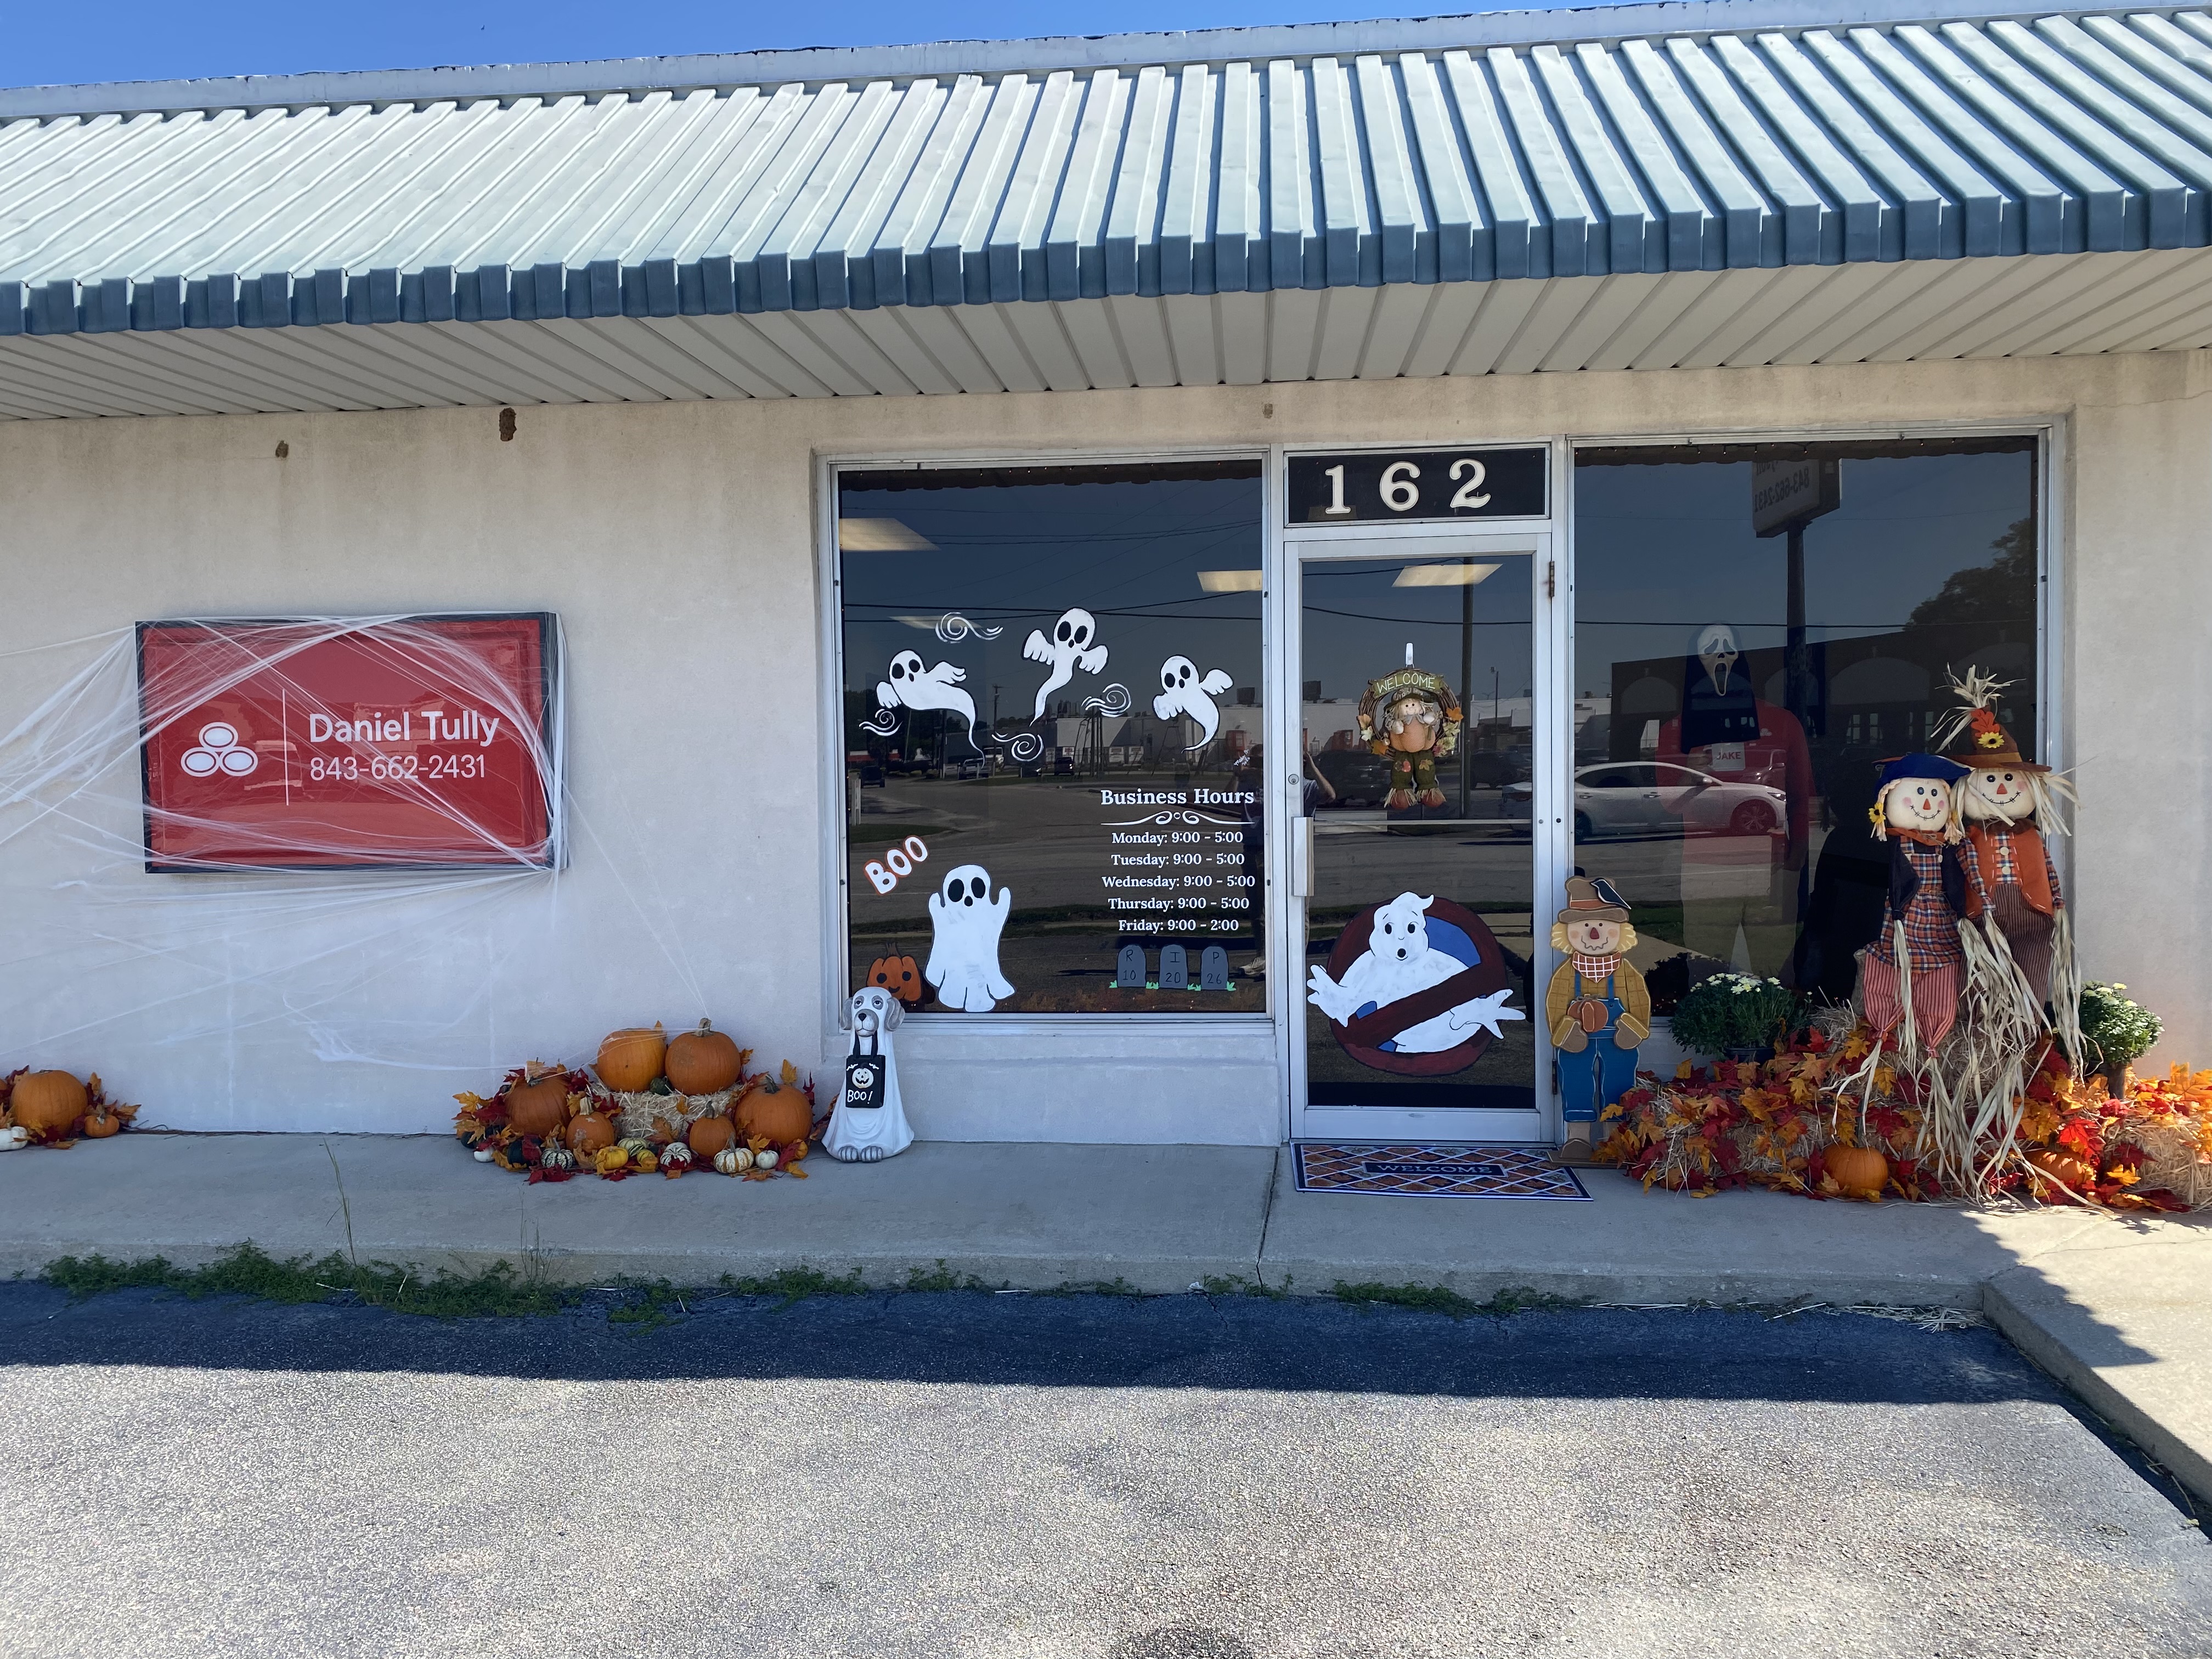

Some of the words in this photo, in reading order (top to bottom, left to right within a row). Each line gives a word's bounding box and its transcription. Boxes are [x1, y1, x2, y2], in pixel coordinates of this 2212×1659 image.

[1325, 459, 1491, 514] 162
[1376, 673, 1435, 693] WELCOME
[309, 712, 410, 743] Daniel
[421, 709, 499, 747] Tully
[1717, 751, 1741, 760] JAKE
[309, 754, 486, 782] 843-662-2431
[1101, 788, 1187, 805] Business
[1194, 788, 1254, 804] Hours
[1111, 832, 1167, 846] Monday:
[1171, 832, 1200, 843] 9:00
[1215, 831, 1243, 843] 5:00
[864, 836, 928, 895] BOO
[1111, 854, 1169, 868] Tuesday:
[1173, 854, 1202, 865] 9:00
[1216, 853, 1245, 865] 5:00
[1102, 876, 1180, 890] Wednesday:
[1183, 876, 1212, 887] 9:00
[1227, 875, 1255, 887] 5:00
[1108, 898, 1174, 912] Thursday:
[1177, 898, 1206, 909] 9:00
[1221, 897, 1250, 909] 5:00
[1118, 919, 1164, 934] Friday:
[1167, 919, 1196, 931] 9:00
[1210, 919, 1239, 930] 2:00
[1126, 949, 1133, 962] R
[1170, 951, 1181, 963] I
[1212, 951, 1220, 964] P
[1122, 969, 1136, 980] 10
[1165, 972, 1181, 983] 20
[1207, 973, 1222, 984] 26
[847, 1089, 873, 1104] BOO!
[1377, 1165, 1492, 1173] WELCOME
